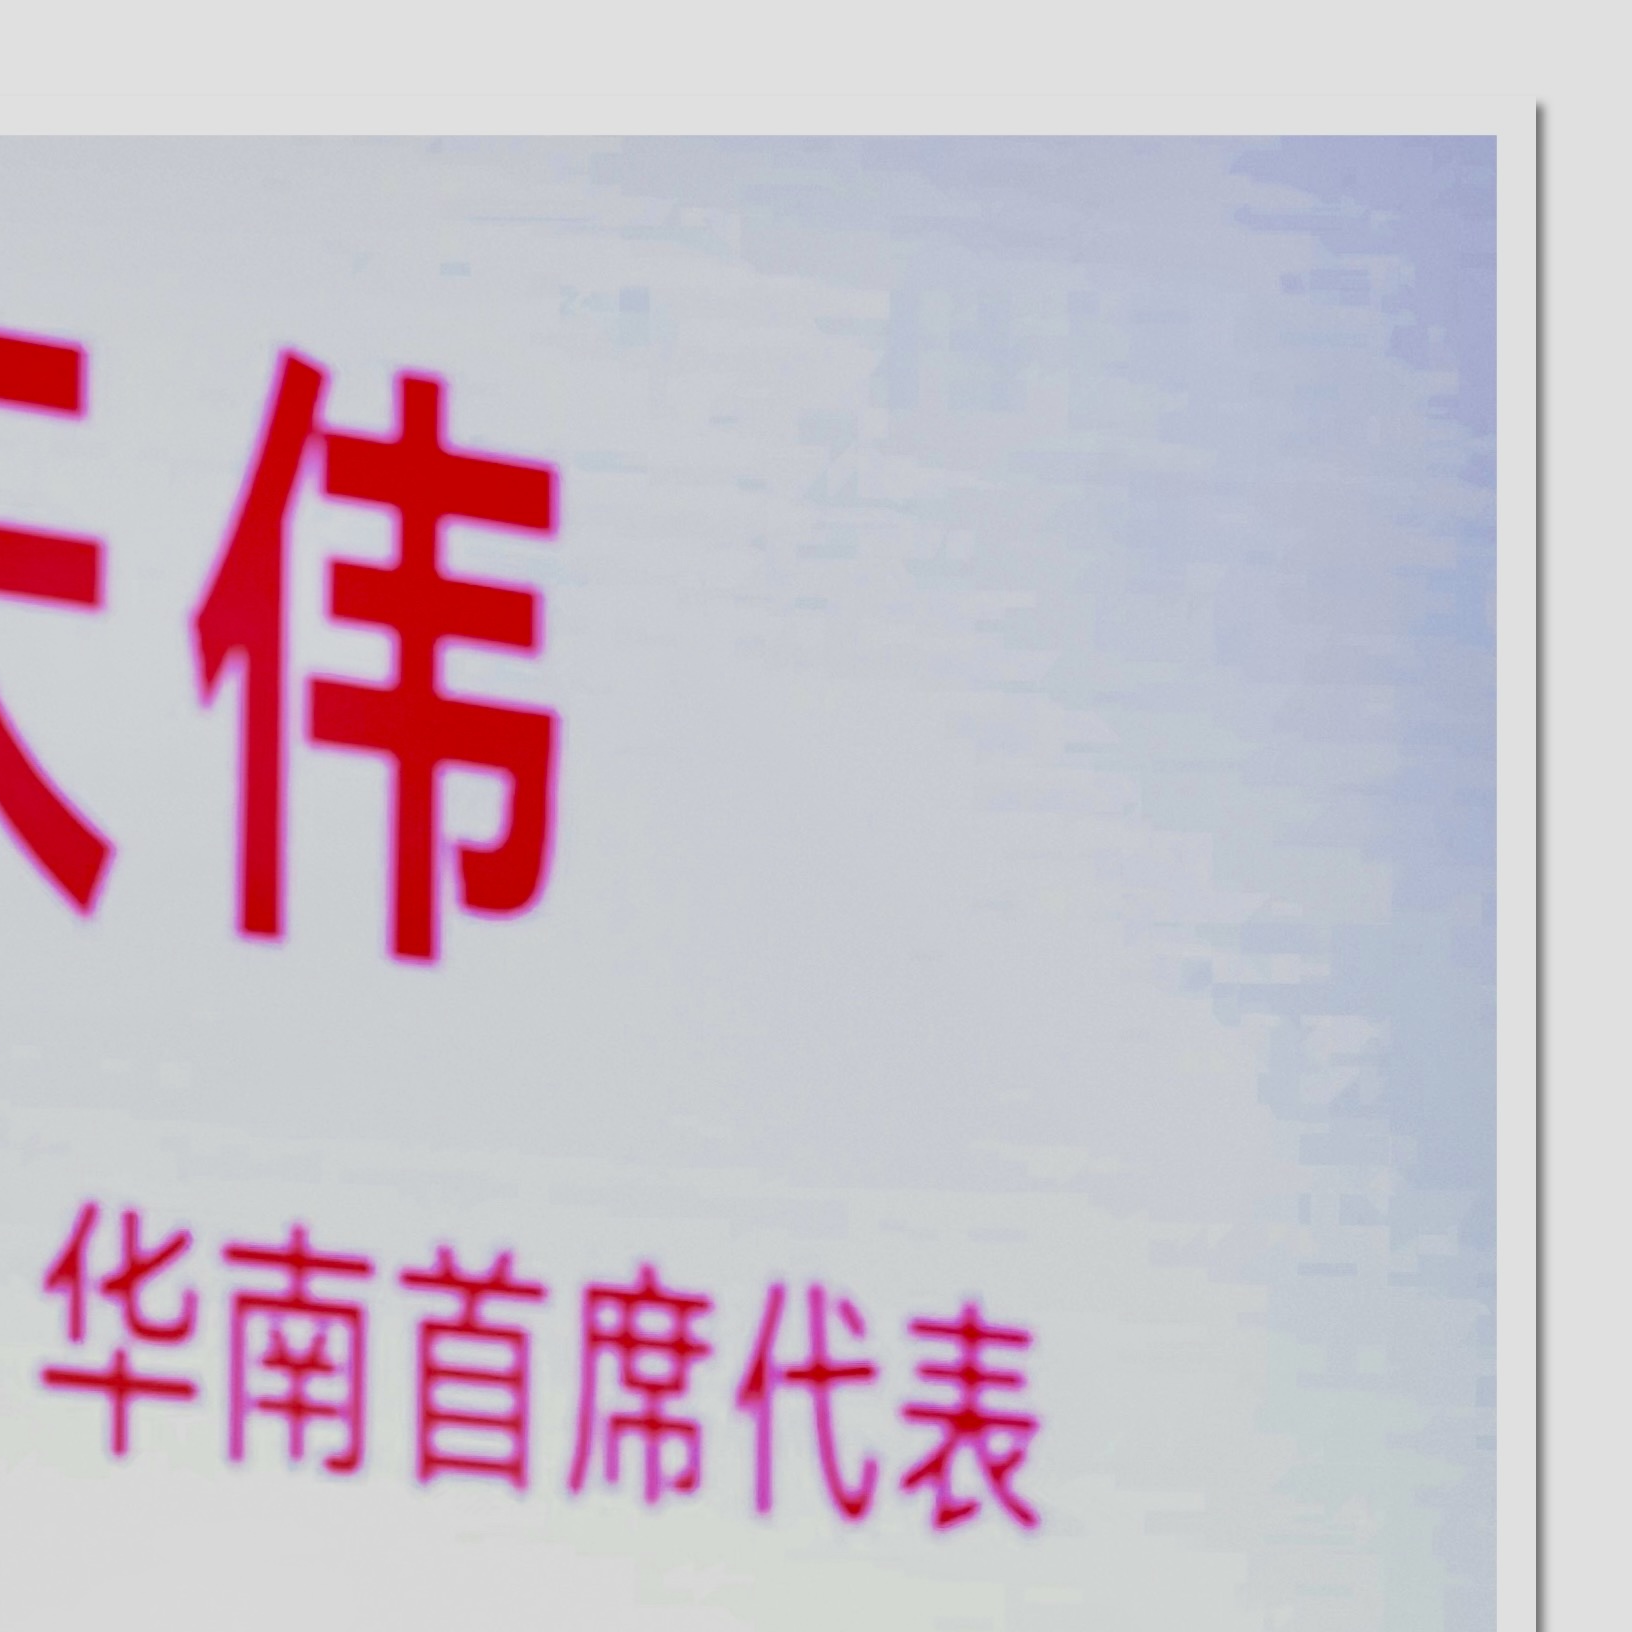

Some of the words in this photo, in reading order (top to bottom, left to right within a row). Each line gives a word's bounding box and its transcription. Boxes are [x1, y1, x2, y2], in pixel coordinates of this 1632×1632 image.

[40, 1200, 1039, 1532] 华南首席代表
